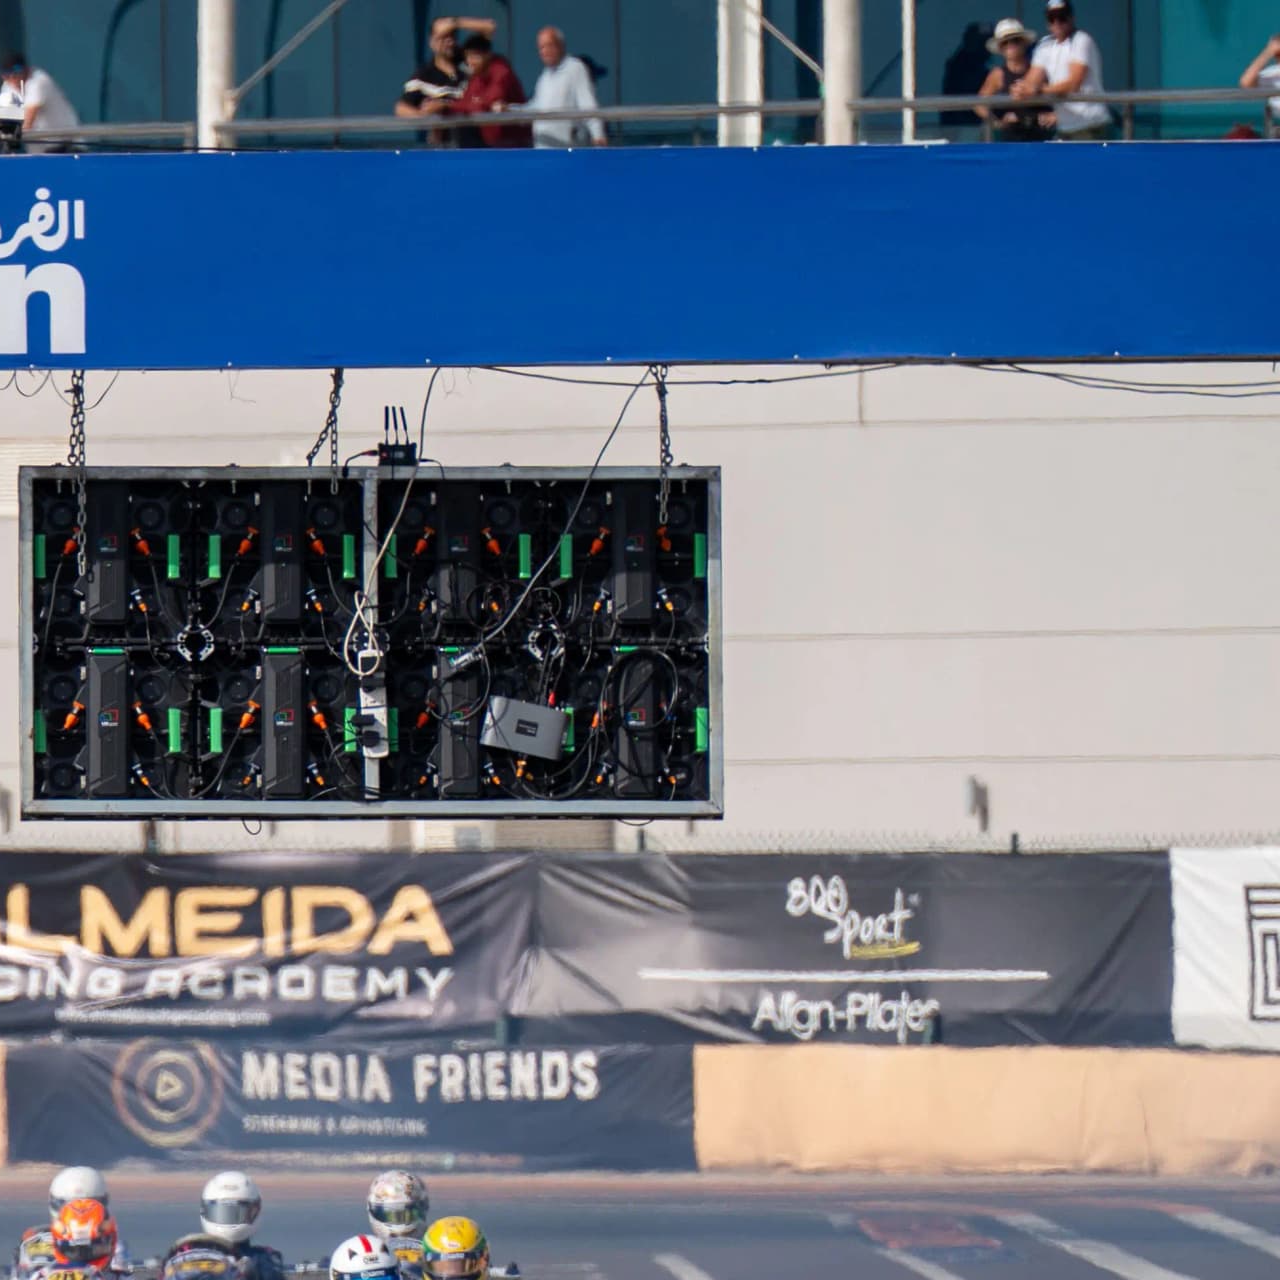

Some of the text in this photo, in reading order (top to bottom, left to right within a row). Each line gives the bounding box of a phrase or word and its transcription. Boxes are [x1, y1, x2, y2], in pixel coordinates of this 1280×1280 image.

[142, 966, 456, 1002] ACADEMY
[241, 1050, 601, 1103] MEDIA FRIENDS
